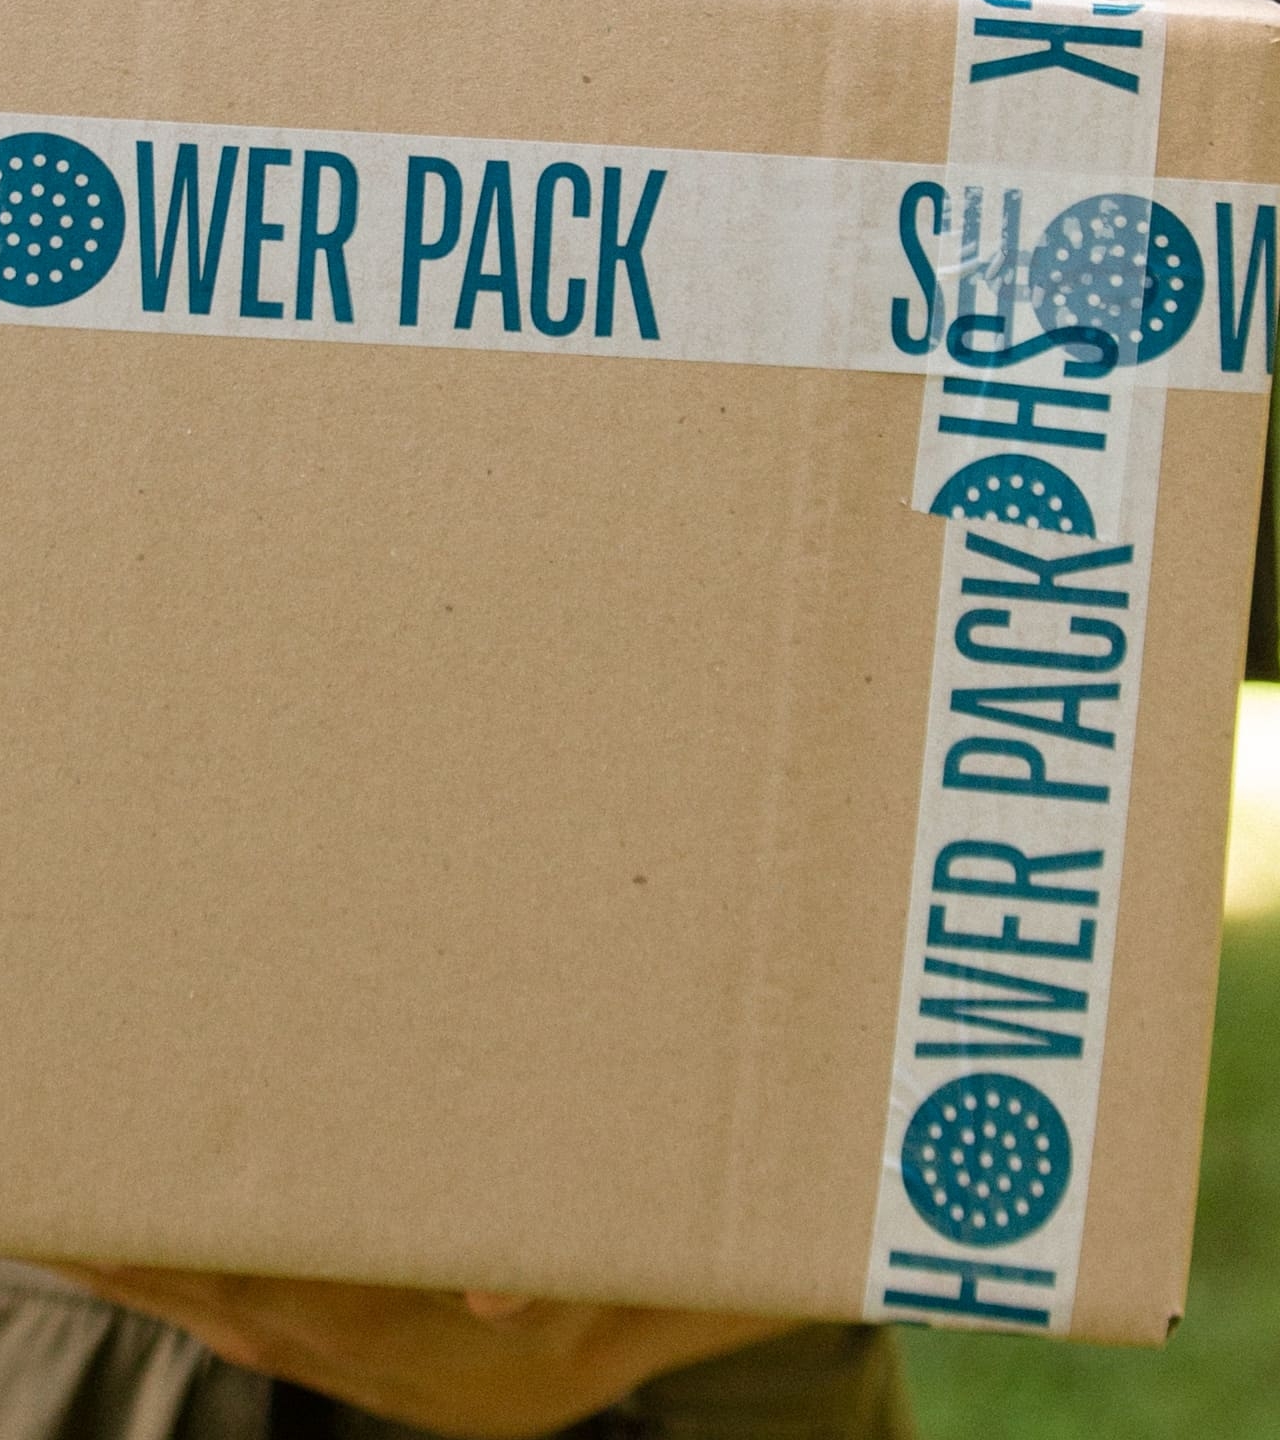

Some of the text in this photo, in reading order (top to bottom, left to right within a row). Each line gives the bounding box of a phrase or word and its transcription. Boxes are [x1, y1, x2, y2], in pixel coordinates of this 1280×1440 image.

[398, 154, 668, 341] PACK
[882, 530, 1135, 1329] HOWER PACK
